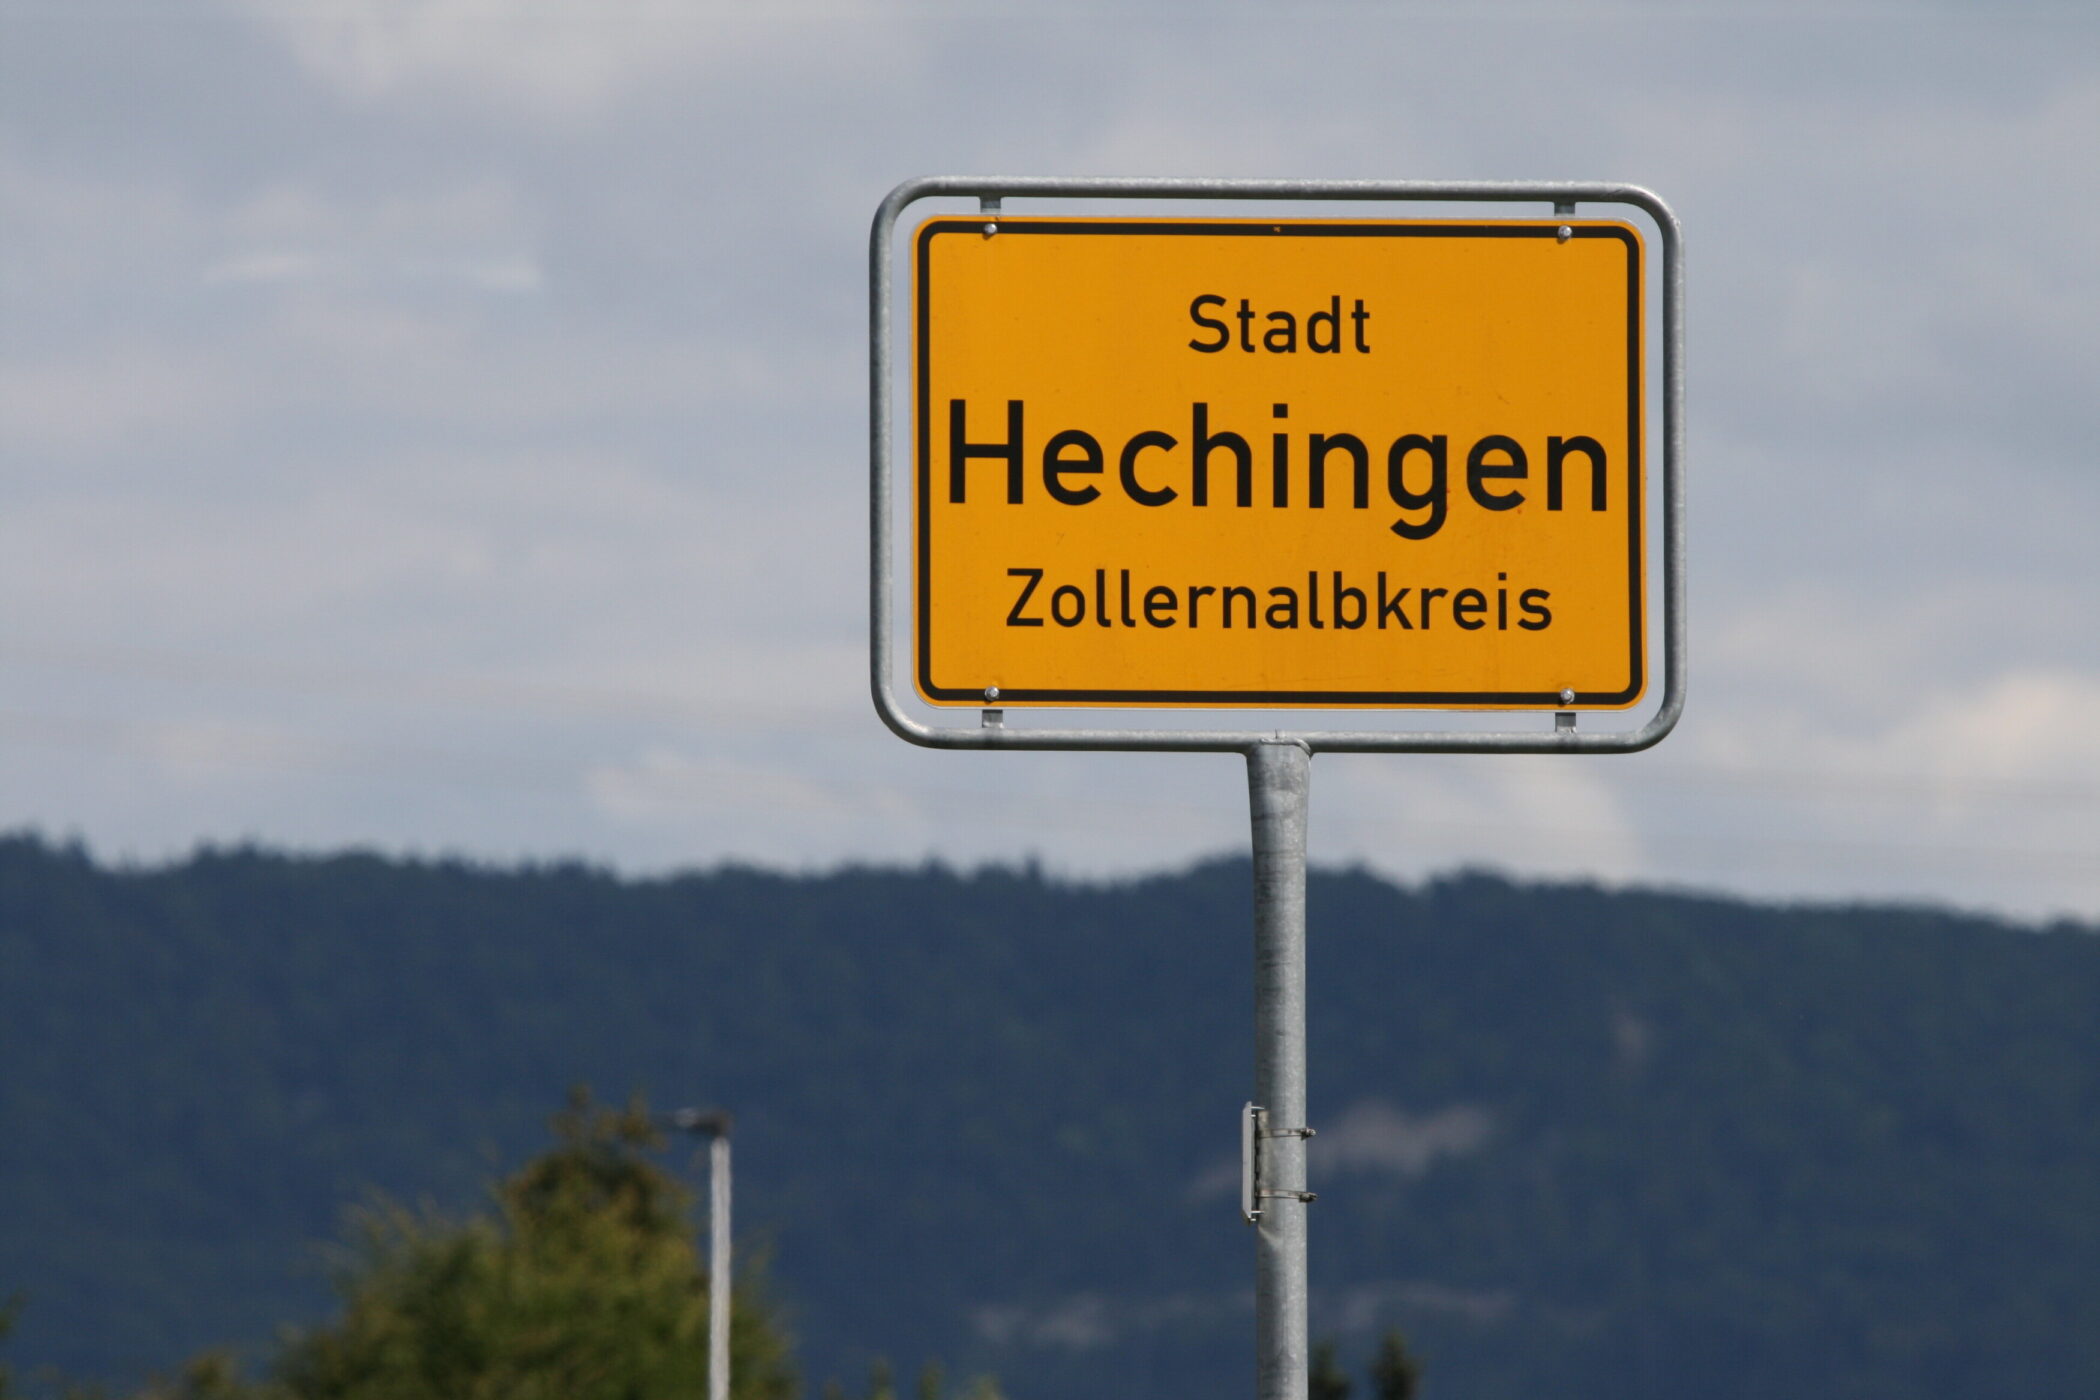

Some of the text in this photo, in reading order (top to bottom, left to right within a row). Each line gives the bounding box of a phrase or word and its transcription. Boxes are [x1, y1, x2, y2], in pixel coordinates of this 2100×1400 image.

[1188, 294, 1371, 354] Stadt
[949, 399, 1607, 541] Hechingen
[1006, 568, 1552, 631] Zollernalbkreis
